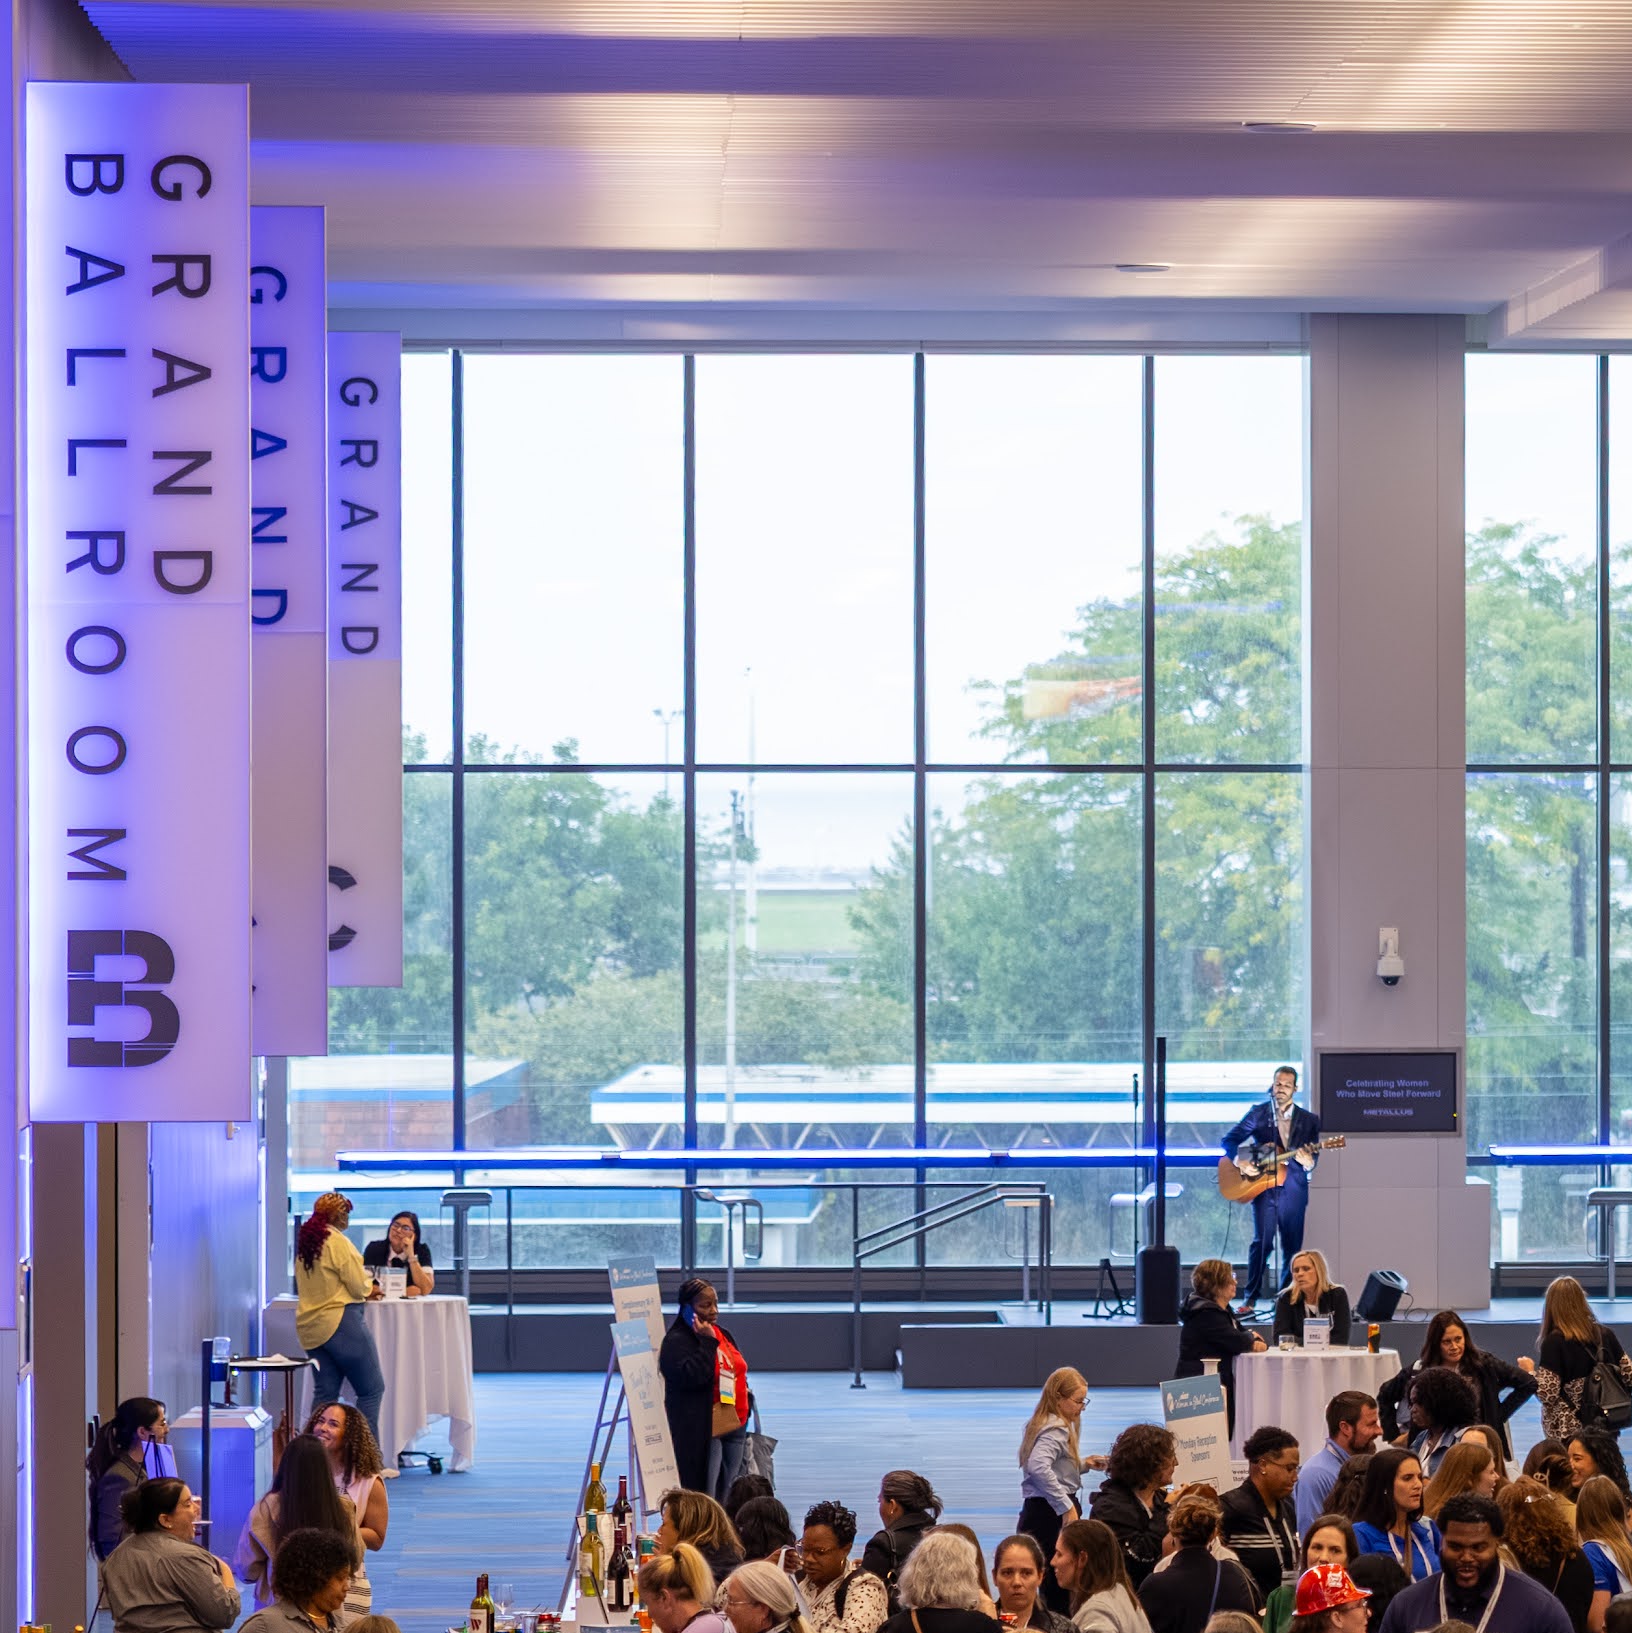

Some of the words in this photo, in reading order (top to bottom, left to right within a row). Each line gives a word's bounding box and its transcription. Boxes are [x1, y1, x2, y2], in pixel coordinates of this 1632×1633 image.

[150, 154, 213, 595] GRAND
[250, 265, 288, 626] GRAND
[65, 153, 127, 881] BALLROOM
[339, 376, 379, 655] GRAND
[67, 929, 180, 1068] B
[1336, 1089, 1356, 1098] Who
[1357, 1090, 1381, 1098] Move
[1382, 1089, 1405, 1098] Steel
[1405, 1089, 1441, 1098] Forward
[1345, 1079, 1395, 1088] Celebrating
[1397, 1079, 1429, 1087] Women
[1363, 1108, 1414, 1116] METALLUS
[1179, 1437, 1197, 1450] Monday
[1196, 1435, 1217, 1447] Reception
[1190, 1450, 1211, 1463] Sponsors
